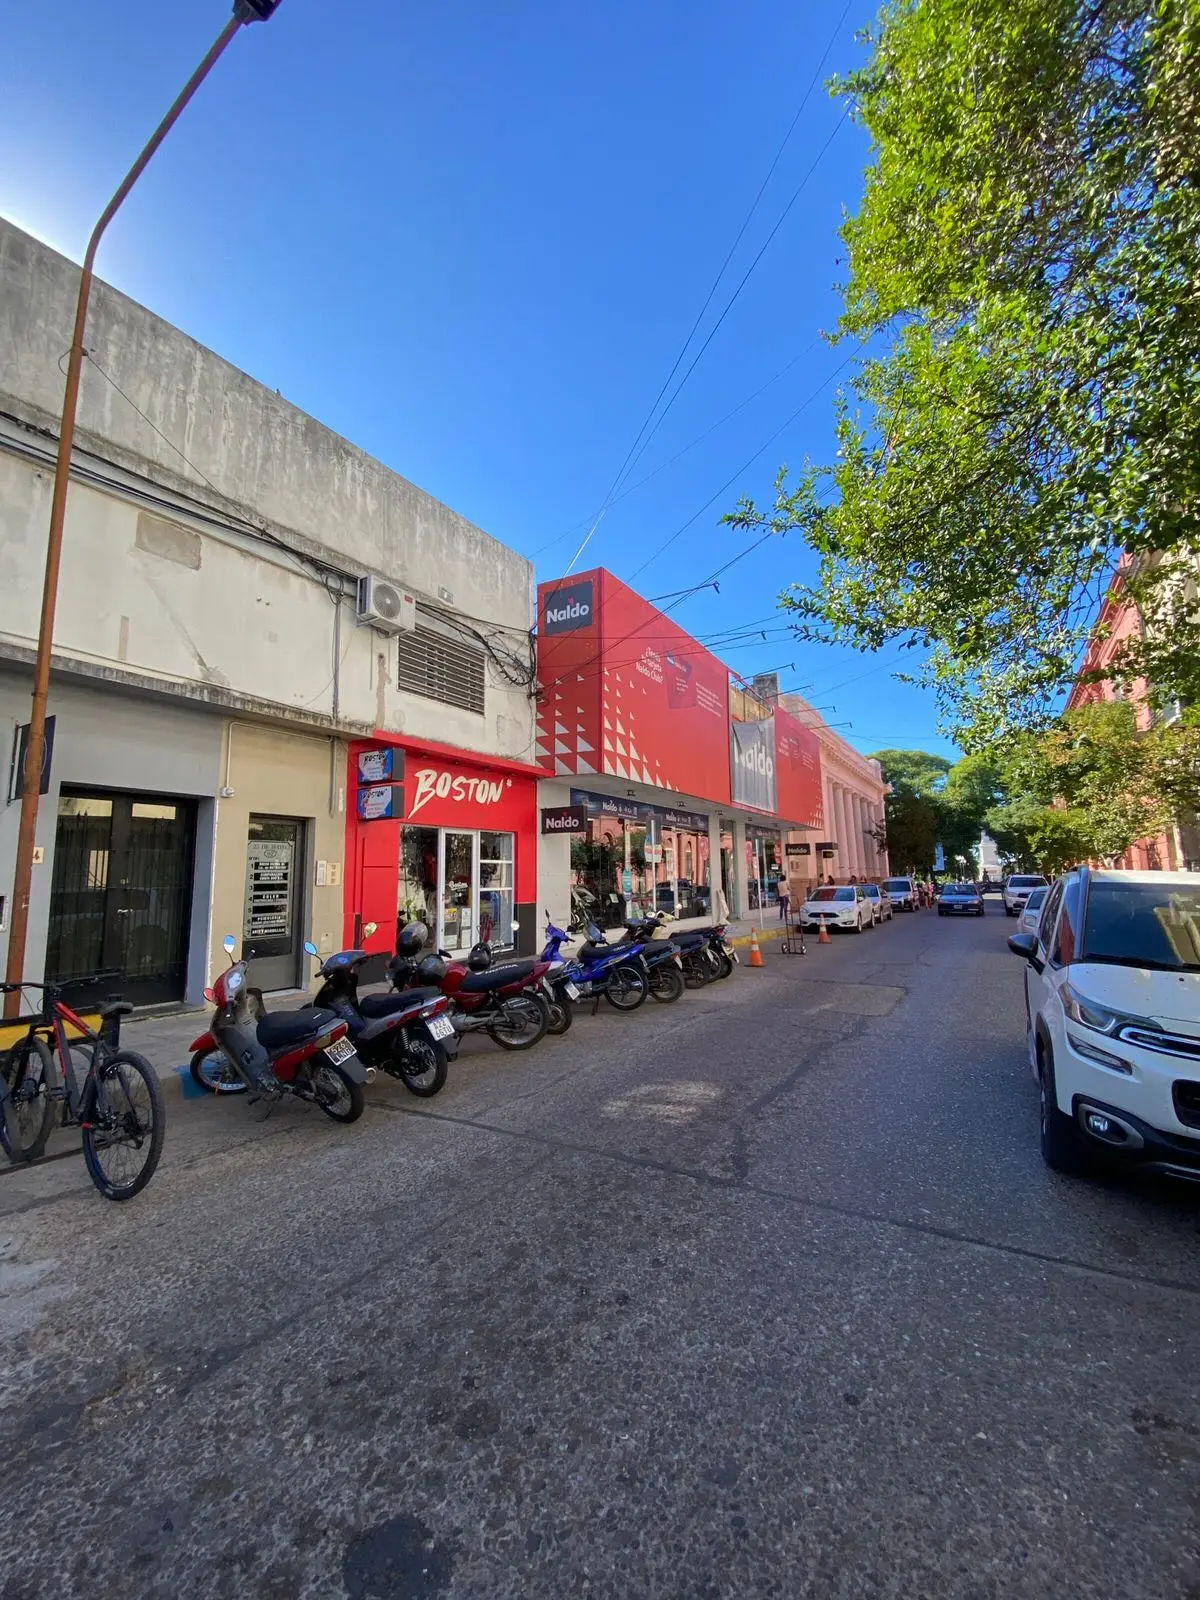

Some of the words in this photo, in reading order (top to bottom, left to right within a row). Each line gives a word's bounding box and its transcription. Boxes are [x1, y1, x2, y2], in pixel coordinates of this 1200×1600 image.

[546, 602, 590, 624] Naldo
[636, 661, 650, 677] Naldo
[408, 769, 504, 819] BOSTON
[602, 801, 618, 812] Naldo
[546, 815, 580, 829] Naldo
[788, 847, 808, 855] Naldo
